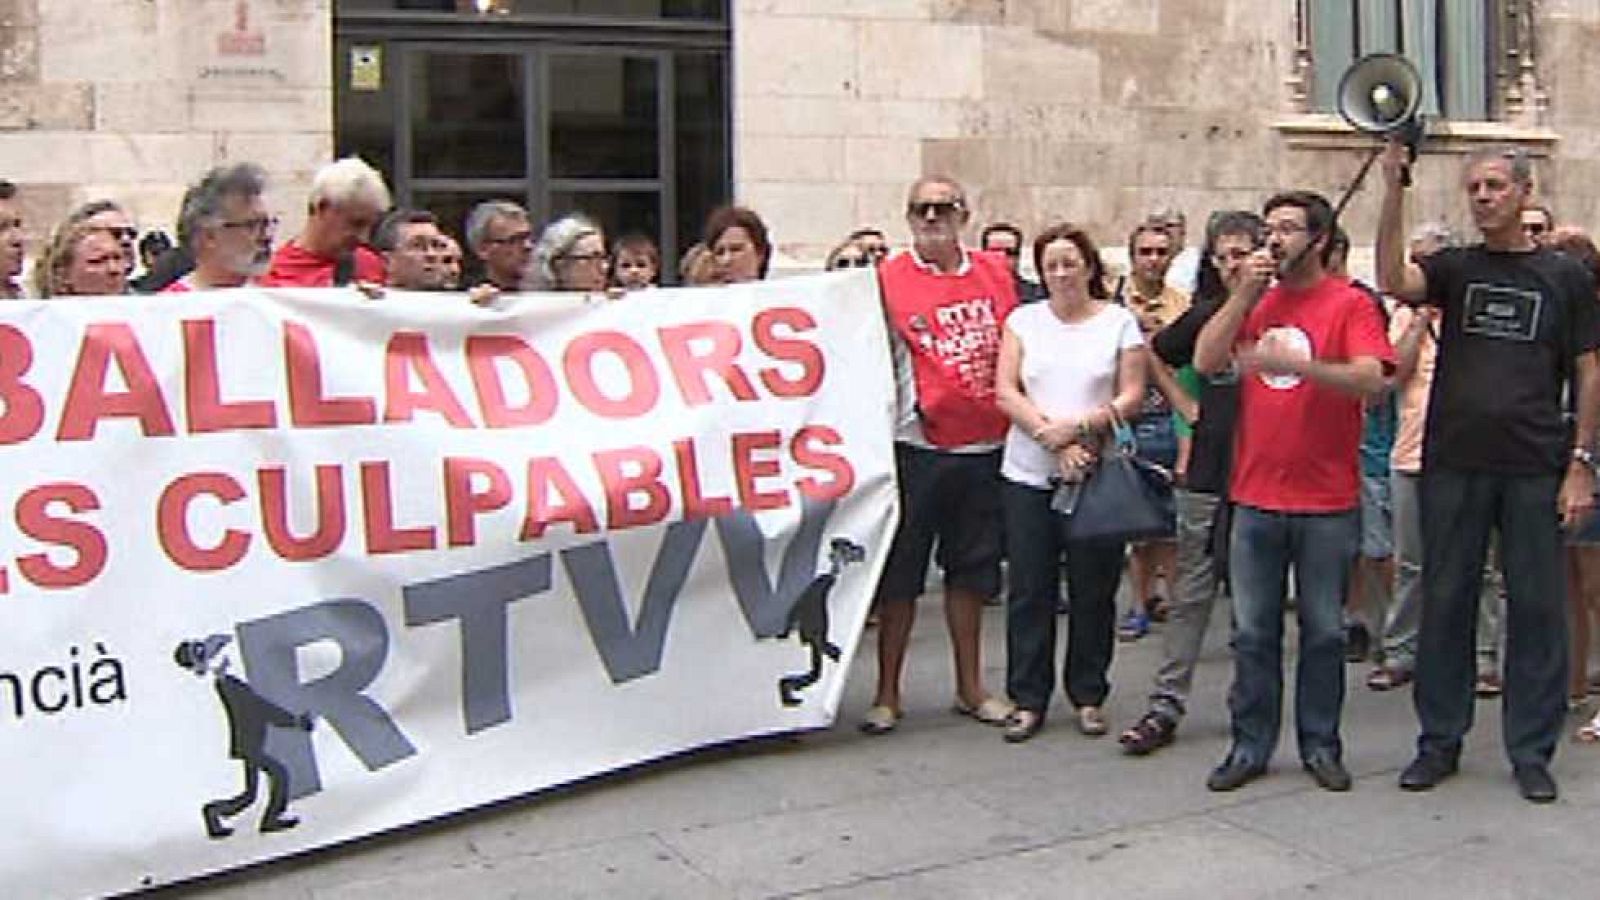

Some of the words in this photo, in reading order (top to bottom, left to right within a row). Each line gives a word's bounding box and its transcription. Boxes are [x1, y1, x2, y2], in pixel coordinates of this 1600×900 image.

[0, 483, 108, 592] S
[156, 425, 856, 571] CULPABLES
[236, 498, 838, 798] RTVV
